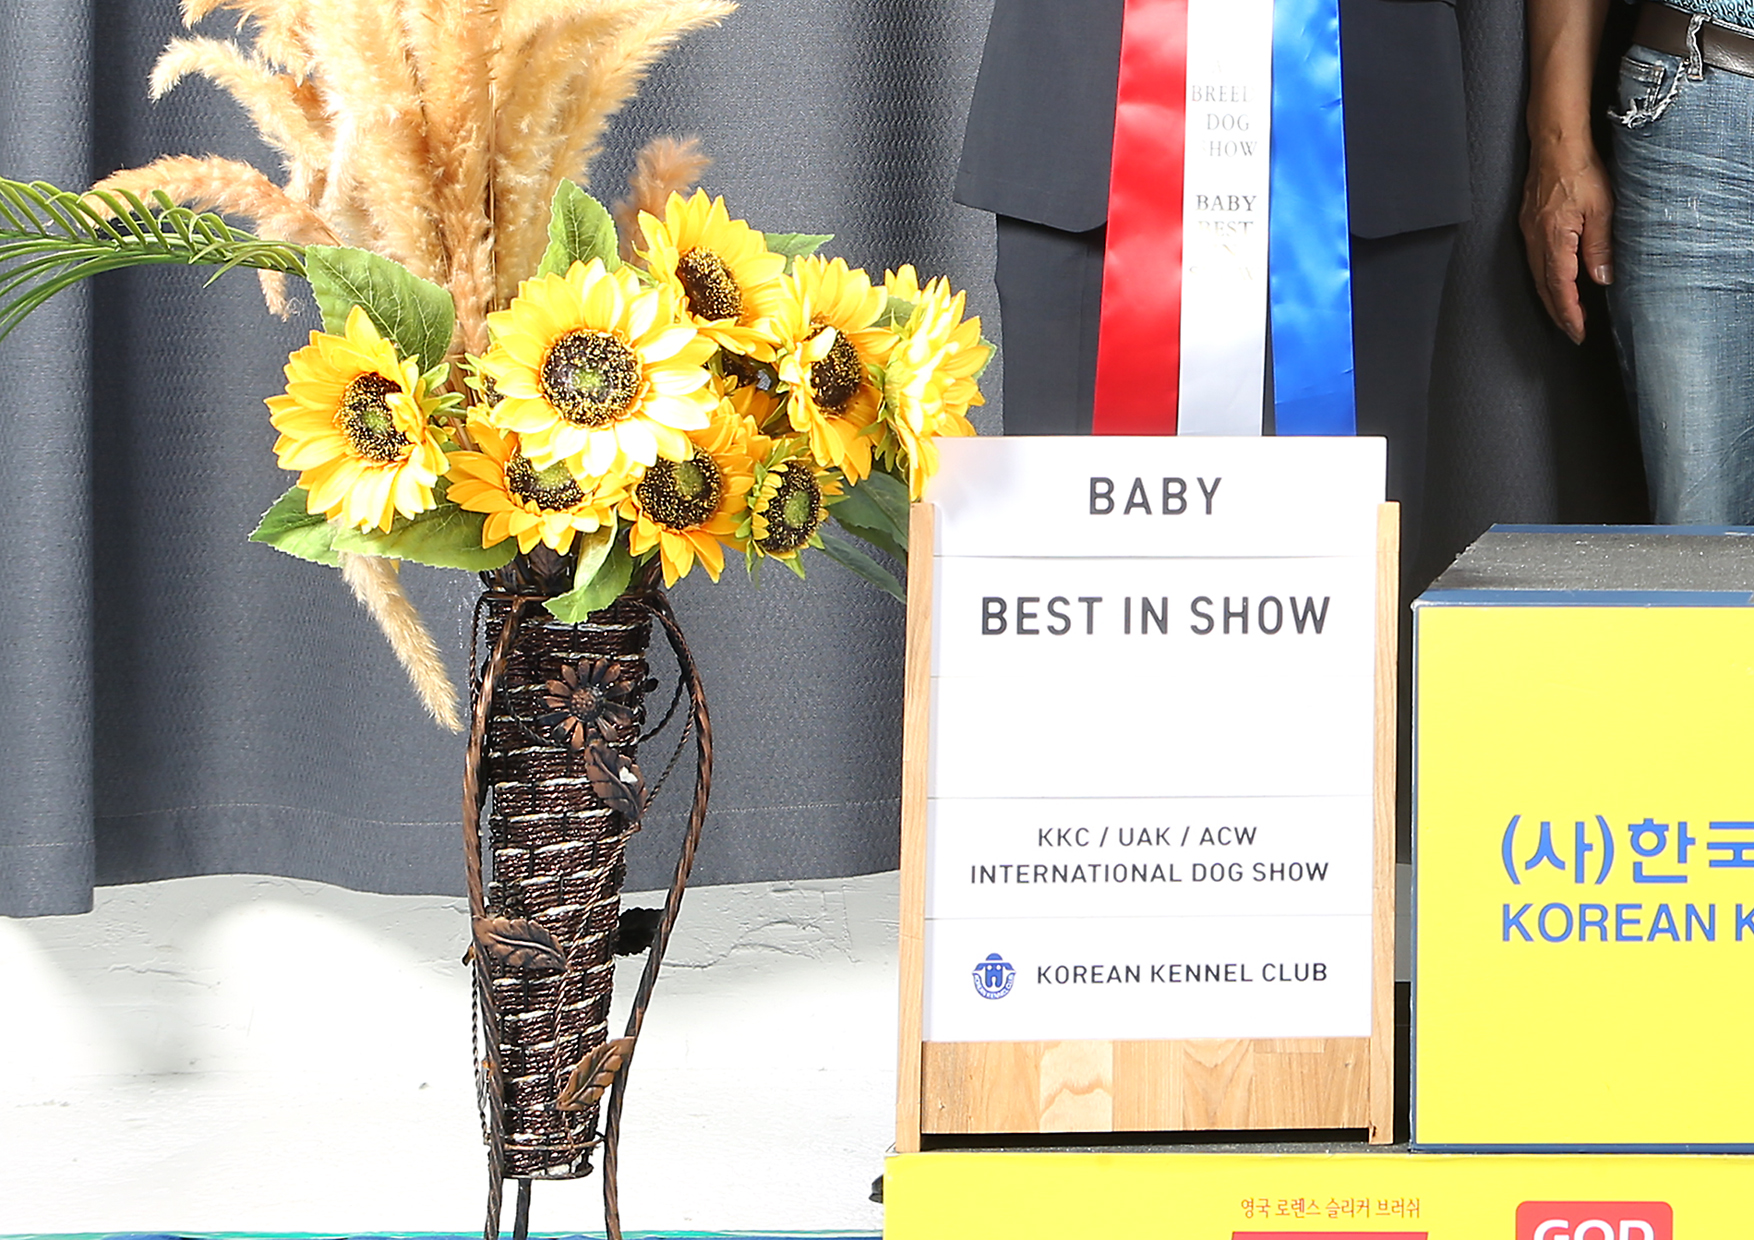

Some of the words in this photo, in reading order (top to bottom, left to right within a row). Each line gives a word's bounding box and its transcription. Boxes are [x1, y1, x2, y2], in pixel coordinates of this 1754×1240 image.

[1207, 113, 1249, 131] DOG
[1196, 195, 1256, 211] BABY
[1090, 477, 1222, 515] BABY
[982, 596, 1103, 635] BEST
[1124, 597, 1168, 634] IN
[1191, 596, 1330, 635] SHOW
[1039, 828, 1089, 847] KKC
[1100, 827, 1108, 847] /
[1119, 827, 1170, 846] UAK
[1181, 826, 1190, 846] /
[1200, 827, 1257, 845] ACW
[972, 864, 1182, 884] INTERNATIONAL
[1192, 863, 1243, 882] DOG
[1253, 862, 1328, 882] SHOW
[1503, 902, 1716, 943] KOREAN
[1038, 965, 1140, 984] KOREAN
[1151, 964, 1253, 983] KENNEL
[1262, 963, 1327, 982] CLUB
[1241, 1197, 1271, 1219] 영국
[1326, 1197, 1369, 1219] 슬리커
[1376, 1197, 1419, 1218] 브러쉬
